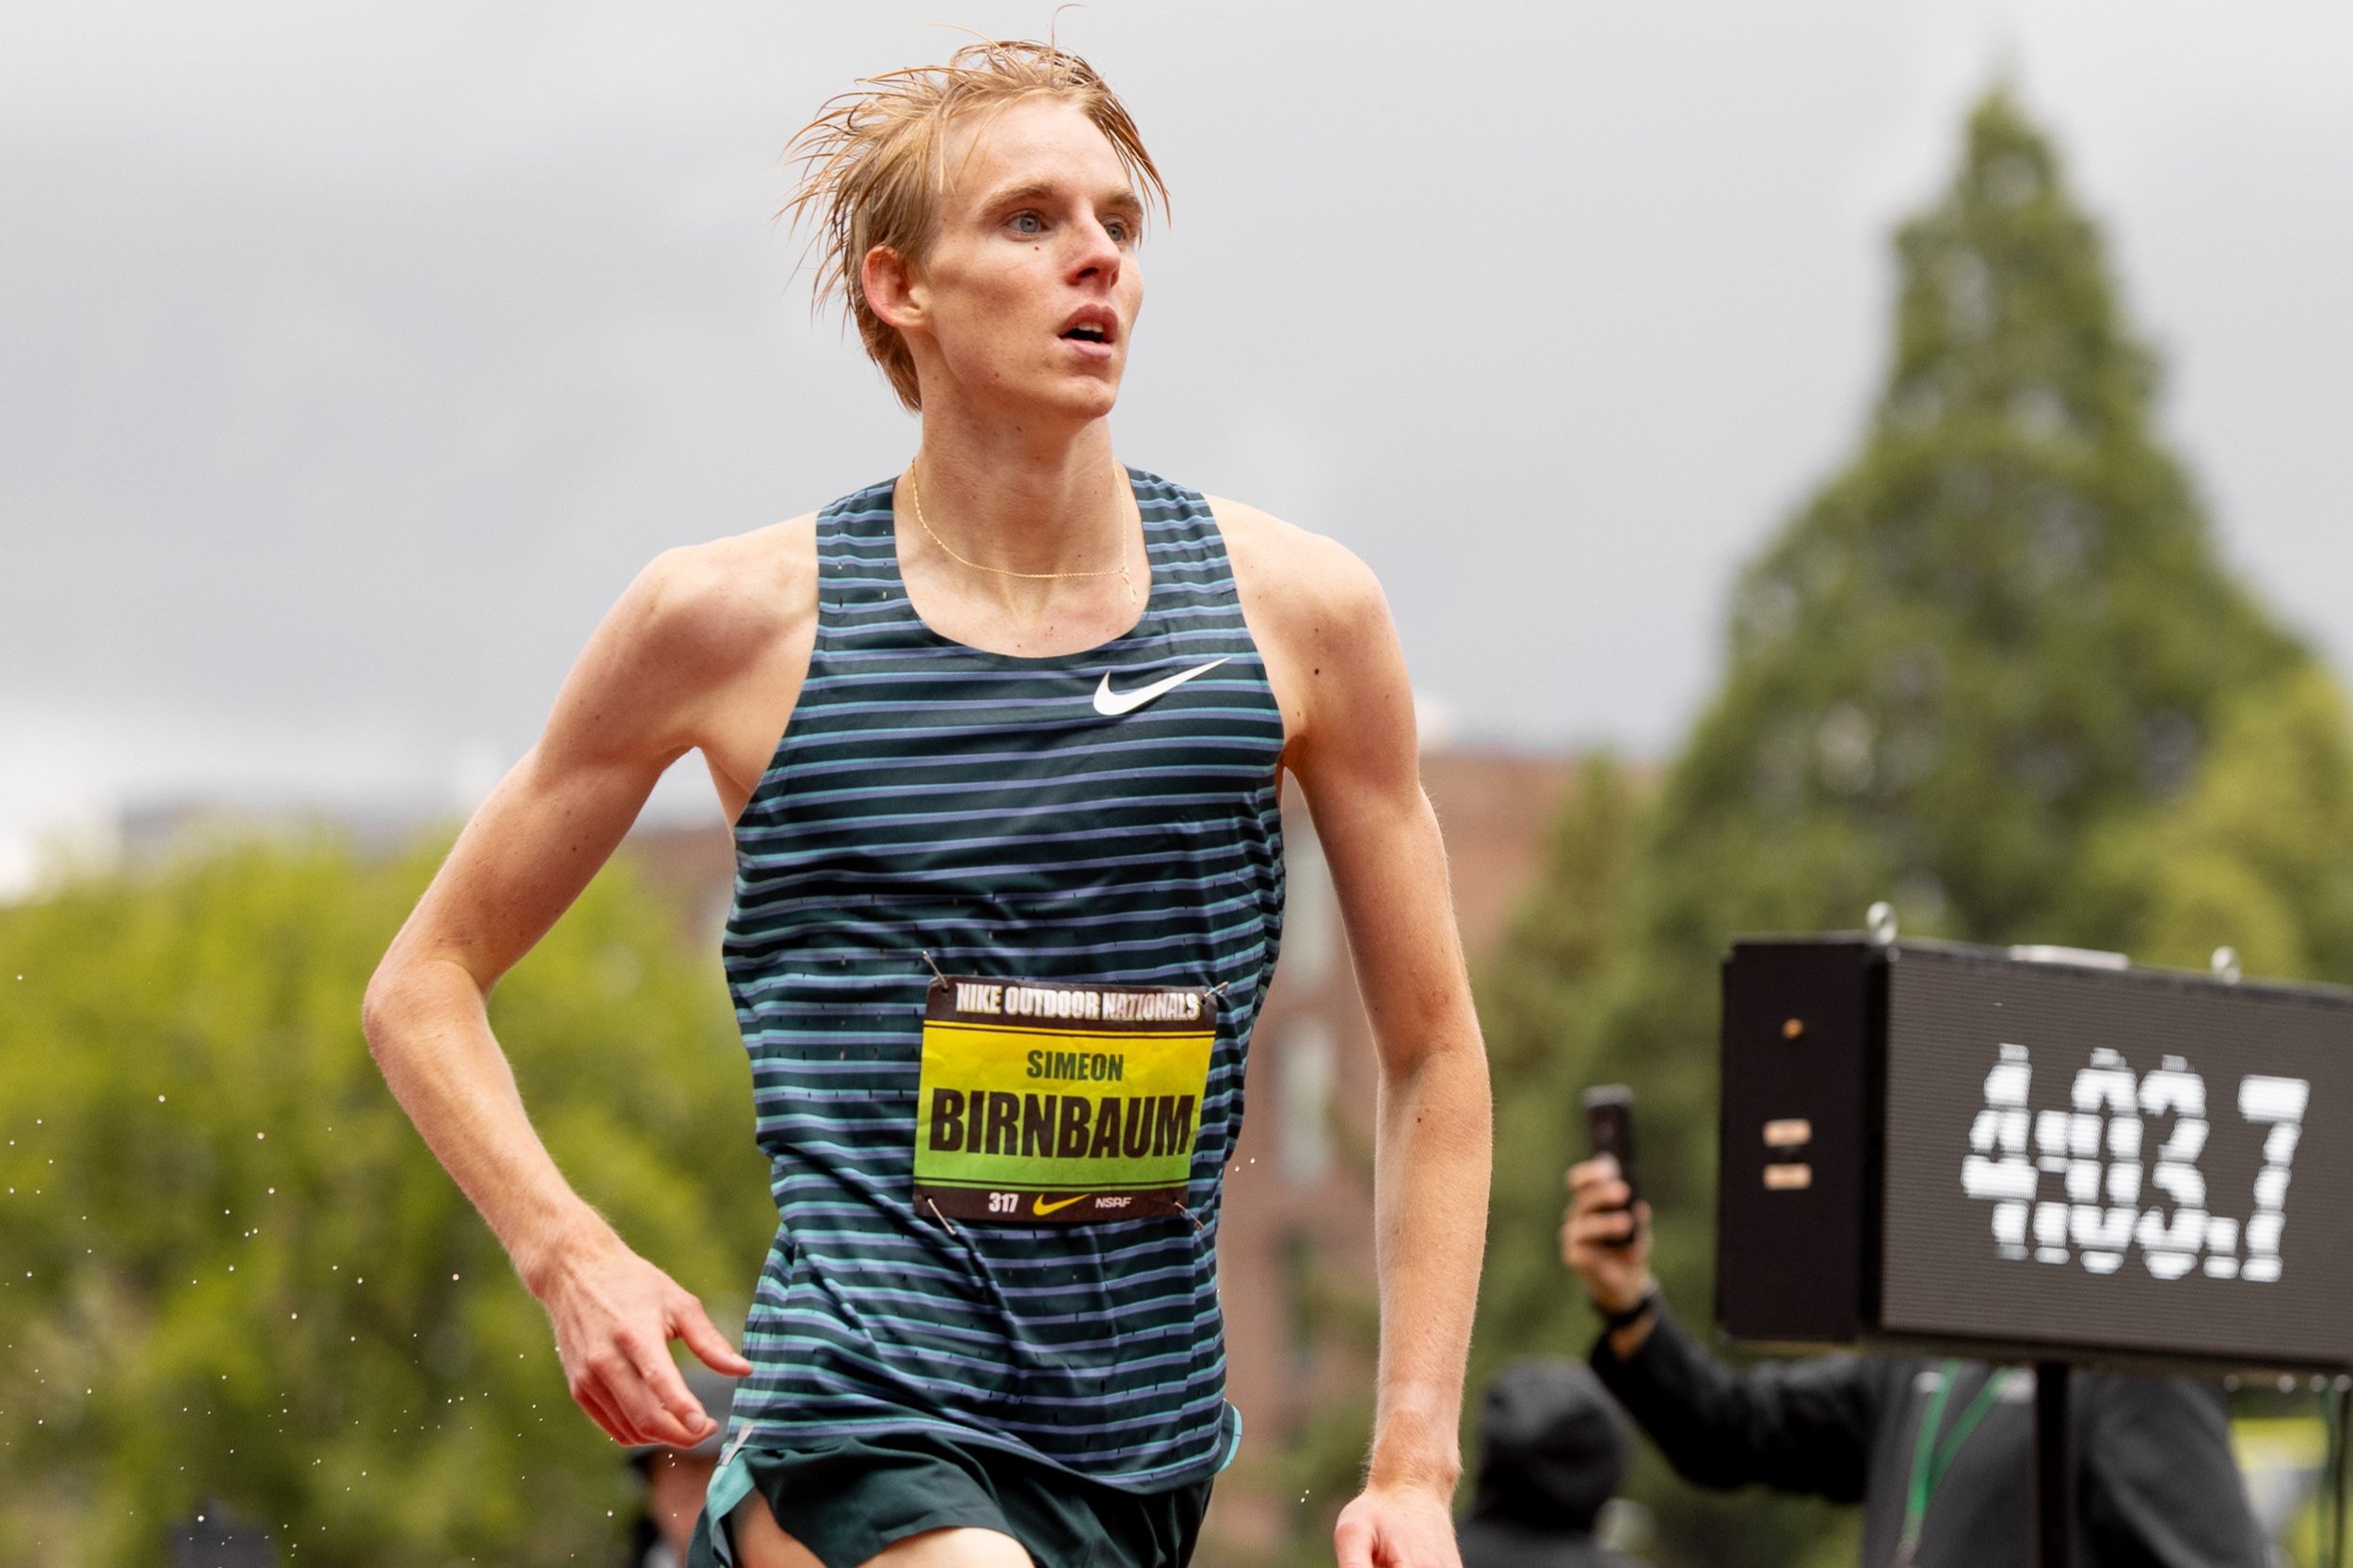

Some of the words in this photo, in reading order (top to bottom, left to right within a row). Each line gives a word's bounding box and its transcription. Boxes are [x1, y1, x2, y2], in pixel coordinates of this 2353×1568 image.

[956, 983, 1000, 1014] NIKE
[1004, 986, 1099, 1020] OUTDOOR
[1102, 991, 1200, 1021] NATIONALS
[1027, 1049, 1124, 1081] SIMEON
[929, 1088, 1195, 1158] BIRNBAUM
[1961, 1043, 2310, 1283] 4:03.7
[988, 1192, 1019, 1212] 317
[1095, 1196, 1132, 1208] NSAF
